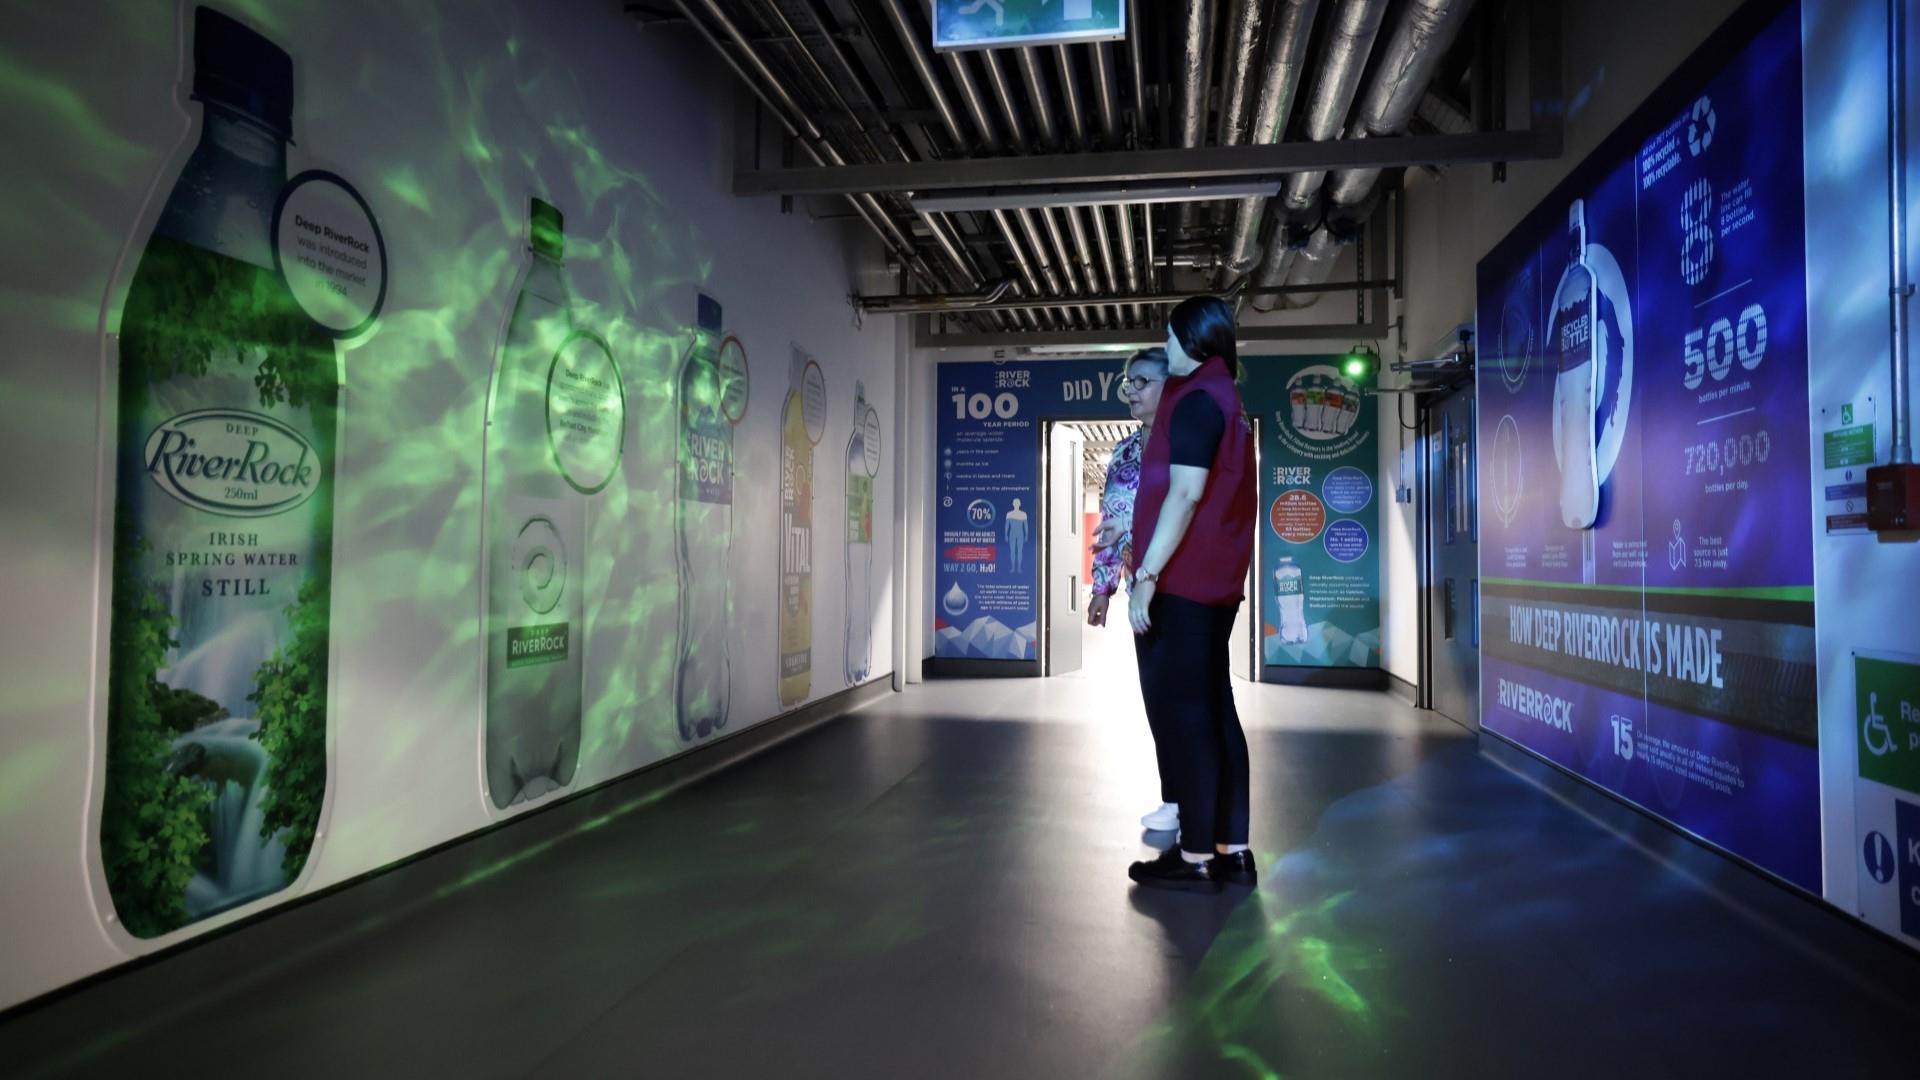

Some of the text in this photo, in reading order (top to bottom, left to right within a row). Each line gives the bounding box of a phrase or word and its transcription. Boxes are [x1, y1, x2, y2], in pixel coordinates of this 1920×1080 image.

[1643, 136, 1675, 175] 100% recycled
[1643, 170, 1656, 191] 100%
[1721, 178, 1750, 203] The water
[1721, 202, 1731, 215] line
[1733, 194, 1743, 207] can
[1721, 204, 1747, 226] 8 bottles
[296, 215, 369, 252] Deep RiverRock
[1680, 177, 1714, 286] 8
[1721, 208, 1756, 239] per second.
[297, 237, 367, 270] was introduced
[297, 255, 366, 287] into the market
[1684, 302, 1768, 391] 500
[998, 370, 1031, 380] RIVER
[998, 378, 1031, 388] ROCK
[1063, 379, 1093, 402] DID
[1698, 380, 1751, 404] bottles per minute.
[951, 392, 1019, 420] 100
[226, 422, 259, 436] DEEP
[1003, 420, 1031, 428] PERIOD
[691, 432, 725, 462] RIVER
[1684, 430, 1770, 476] 720,000
[147, 428, 311, 489] RiverRock
[690, 456, 725, 487] ROCK
[1277, 466, 1311, 476] RIVER
[1277, 475, 1311, 486] ROCK
[224, 487, 258, 501] 250ml
[1705, 482, 1724, 494] bottles
[1725, 481, 1735, 492] per
[971, 507, 992, 521] 70%
[209, 533, 258, 547] IRISH
[1699, 535, 1722, 545] The best
[166, 552, 298, 566] SPRING WATER
[1694, 549, 1711, 558] source
[1718, 547, 1728, 558] just
[1702, 558, 1712, 568] km
[944, 562, 959, 573] WAY
[966, 562, 978, 575] GO,
[201, 578, 271, 598] STILL
[512, 636, 565, 655] RIVERROCK
[1509, 604, 1724, 689] HOW DEEP RIVERROCK IS MADE
[1499, 678, 1573, 733] RIVERROCK
[1610, 714, 1634, 761] 15
[1696, 751, 1710, 764] Deep
[1738, 777, 1744, 788] to
